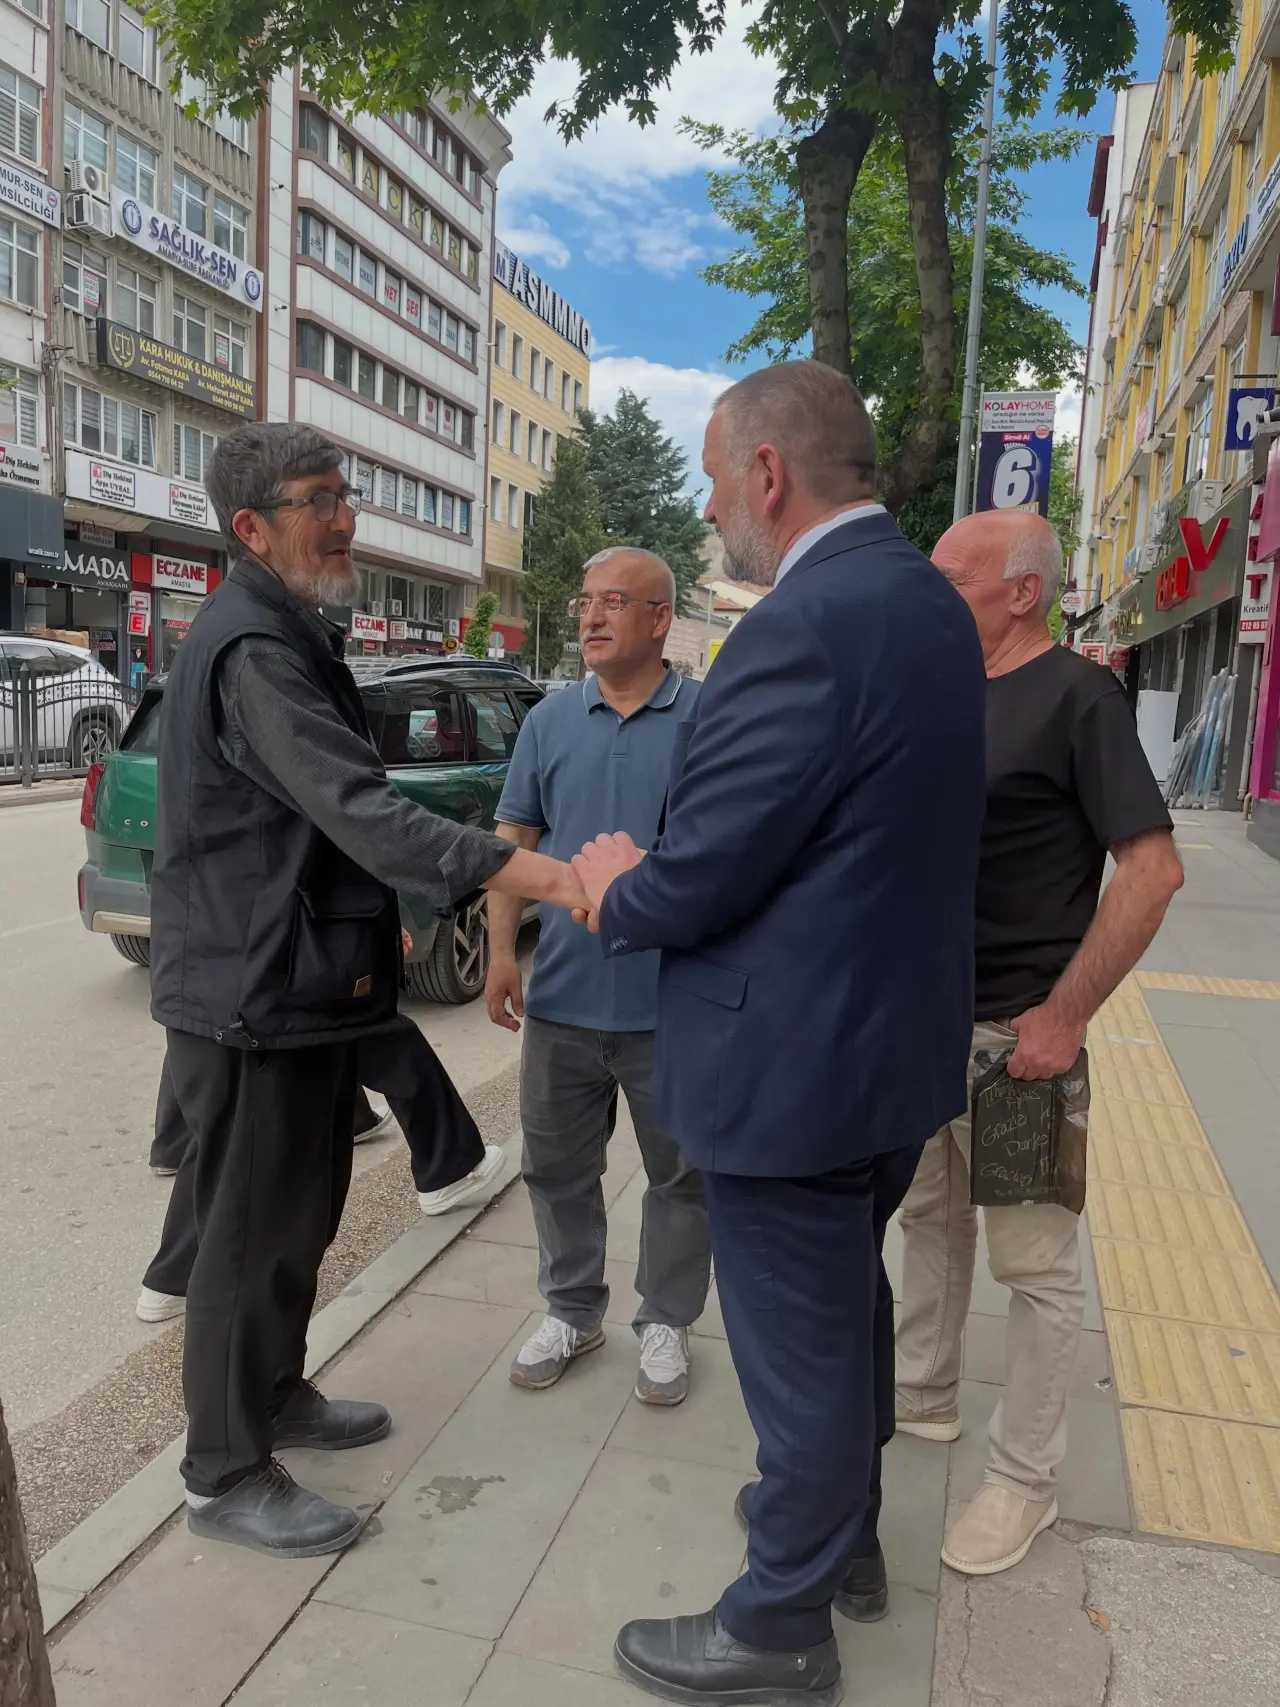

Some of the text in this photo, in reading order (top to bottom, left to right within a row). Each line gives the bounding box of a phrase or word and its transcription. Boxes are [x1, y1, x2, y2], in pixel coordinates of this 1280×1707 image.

[151, 216, 237, 282] SAĞLIK-SEN
[140, 338, 164, 360] KARA
[165, 349, 194, 371] HUKUK
[194, 362, 201, 374] &
[201, 364, 253, 396] DANIŞMANLIK
[984, 401, 1054, 411] KOLAYHOME
[992, 448, 1036, 509] 6
[41, 550, 130, 582] MADA
[156, 559, 205, 582] ECZANE
[1243, 605, 1269, 613] Kreatif
[133, 616, 143, 630] E
